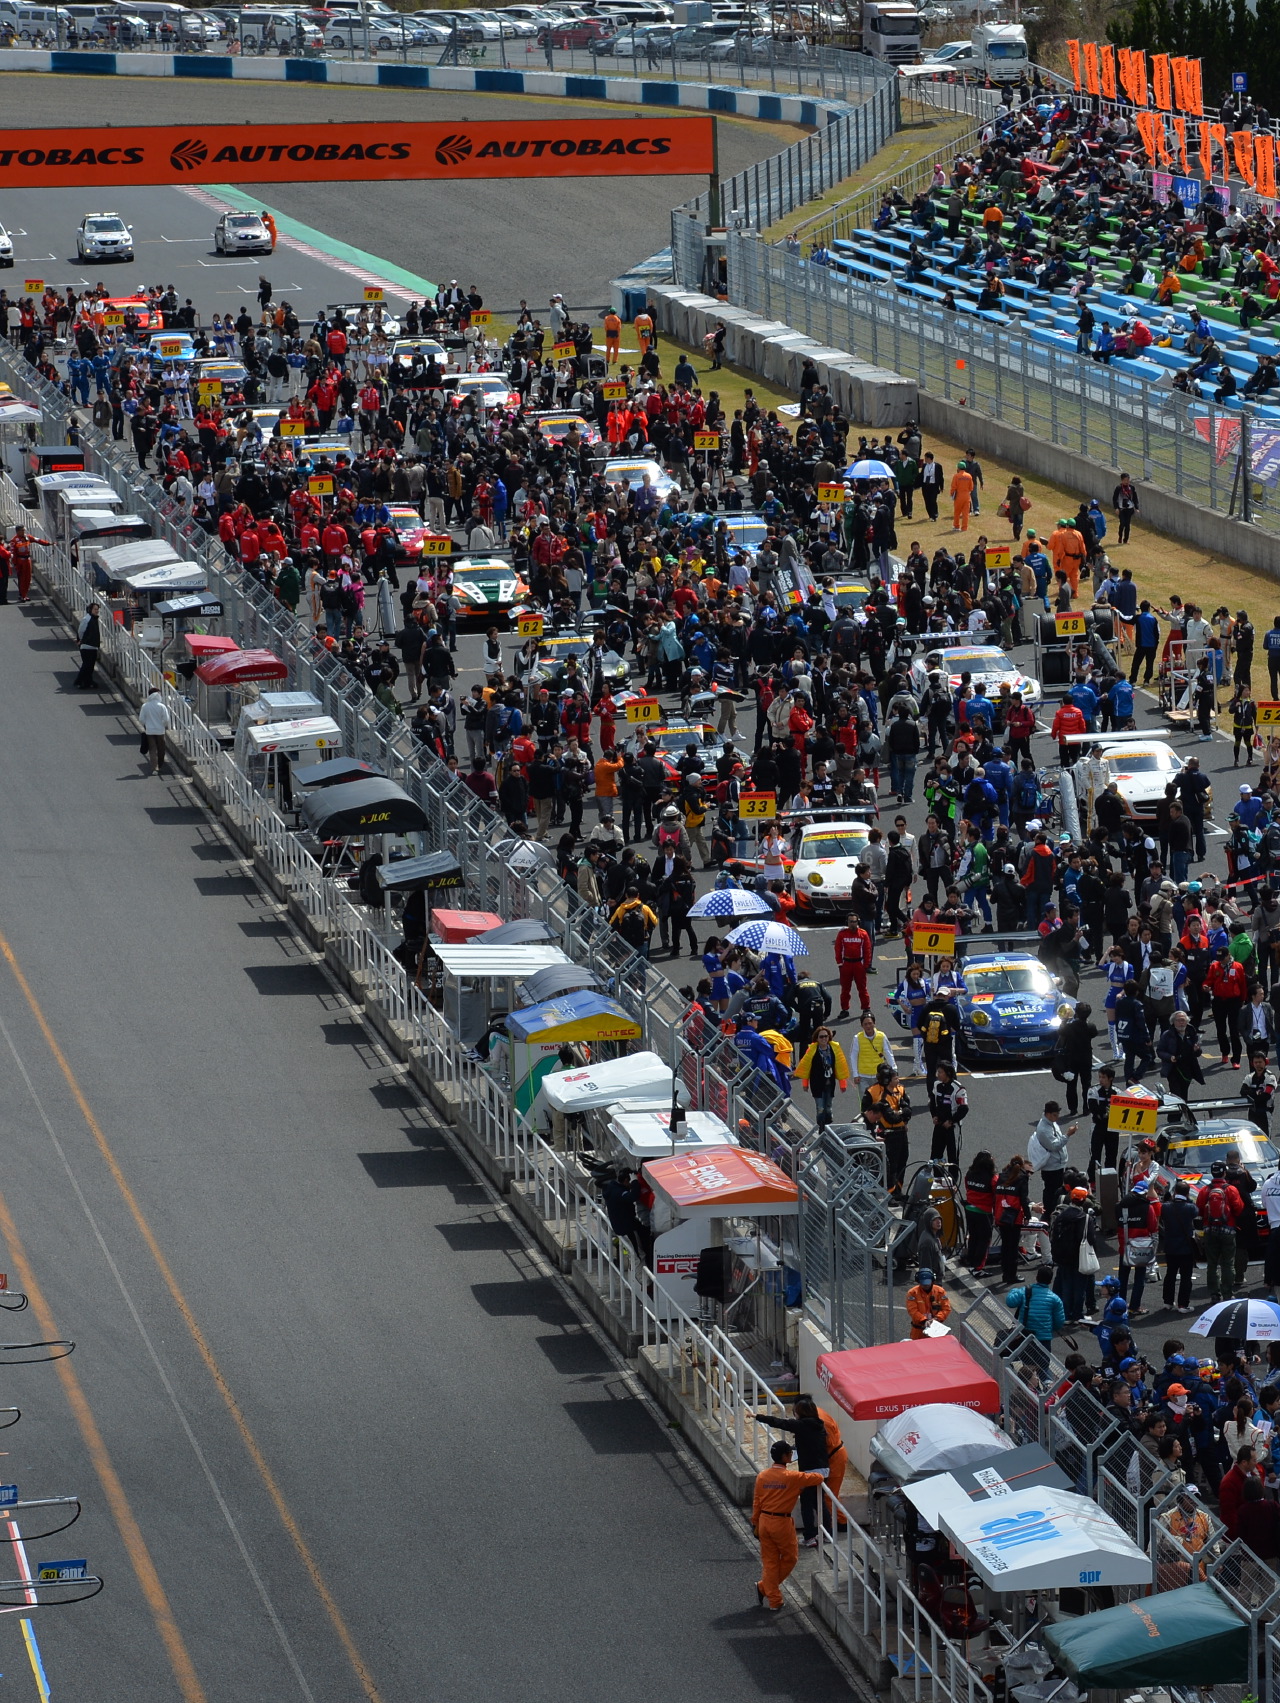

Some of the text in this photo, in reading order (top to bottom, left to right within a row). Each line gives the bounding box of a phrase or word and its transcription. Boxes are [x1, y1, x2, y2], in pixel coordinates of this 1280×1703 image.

[212, 142, 411, 161] AUTOBACS
[475, 137, 672, 158] AUTOBACS
[0, 147, 146, 166] TOBACS
[162, 345, 180, 354] 360
[700, 437, 714, 446] 22
[428, 542, 446, 551] 50
[995, 554, 1001, 564] 2
[522, 622, 539, 633] 62
[1062, 620, 1078, 631] 48
[634, 705, 651, 718] 10
[747, 800, 768, 813] 33
[864, 851, 873, 865] 6
[765, 937, 788, 946] ENDLESS
[928, 934, 940, 947] 0
[998, 1005, 1043, 1015] ENDLESS
[1120, 1108, 1145, 1125] 11
[690, 1165, 732, 1188] ENEOS
[0, 1489, 14, 1502] pr
[979, 1510, 1064, 1551] apr
[43, 1570, 55, 1580] 30
[1079, 1570, 1102, 1584] apr
